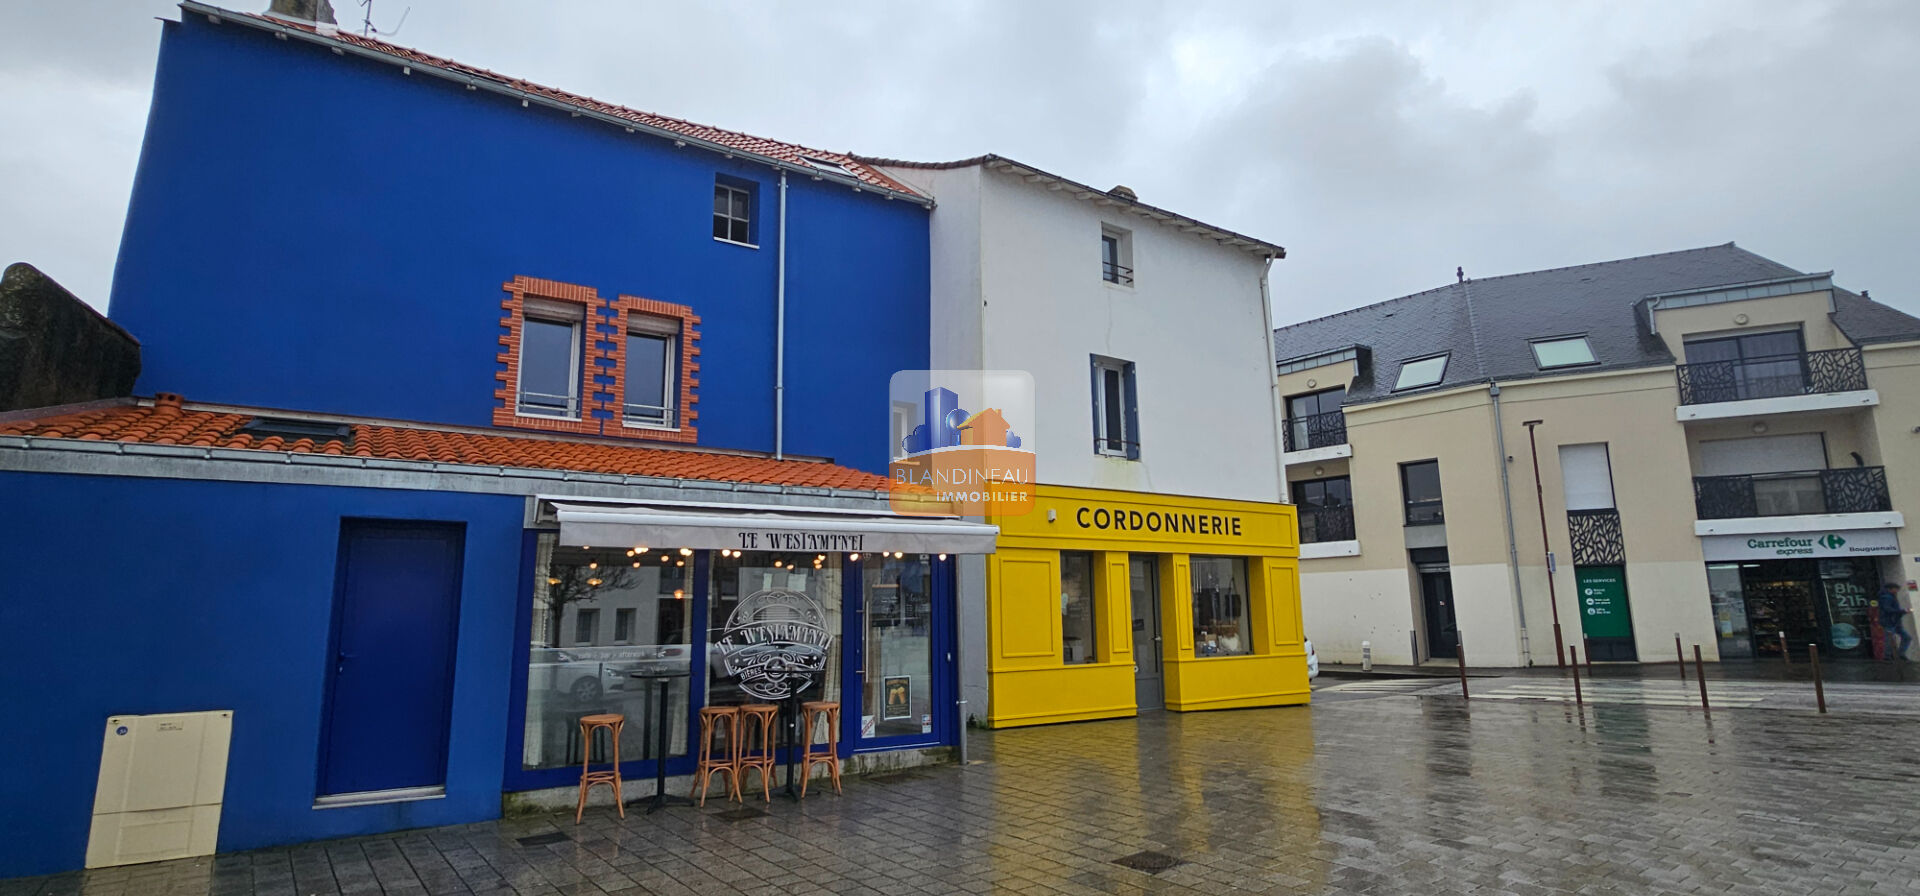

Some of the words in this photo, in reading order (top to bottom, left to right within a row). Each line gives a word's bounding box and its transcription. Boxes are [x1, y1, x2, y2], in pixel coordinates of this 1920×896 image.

[1076, 507, 1243, 537] CORDONNERIE
[738, 532, 758, 549] LE
[766, 532, 865, 551] WESTAMINET
[1747, 537, 1813, 549] Carrefour
[1776, 547, 1813, 556] express
[1849, 544, 1897, 553] Bouguenais
[1834, 582, 1858, 593] 8h
[1835, 593, 1868, 607] 21h
[715, 635, 737, 655] LE
[740, 623, 834, 650] WESTAMINET
[740, 666, 763, 679] BIÈRES
